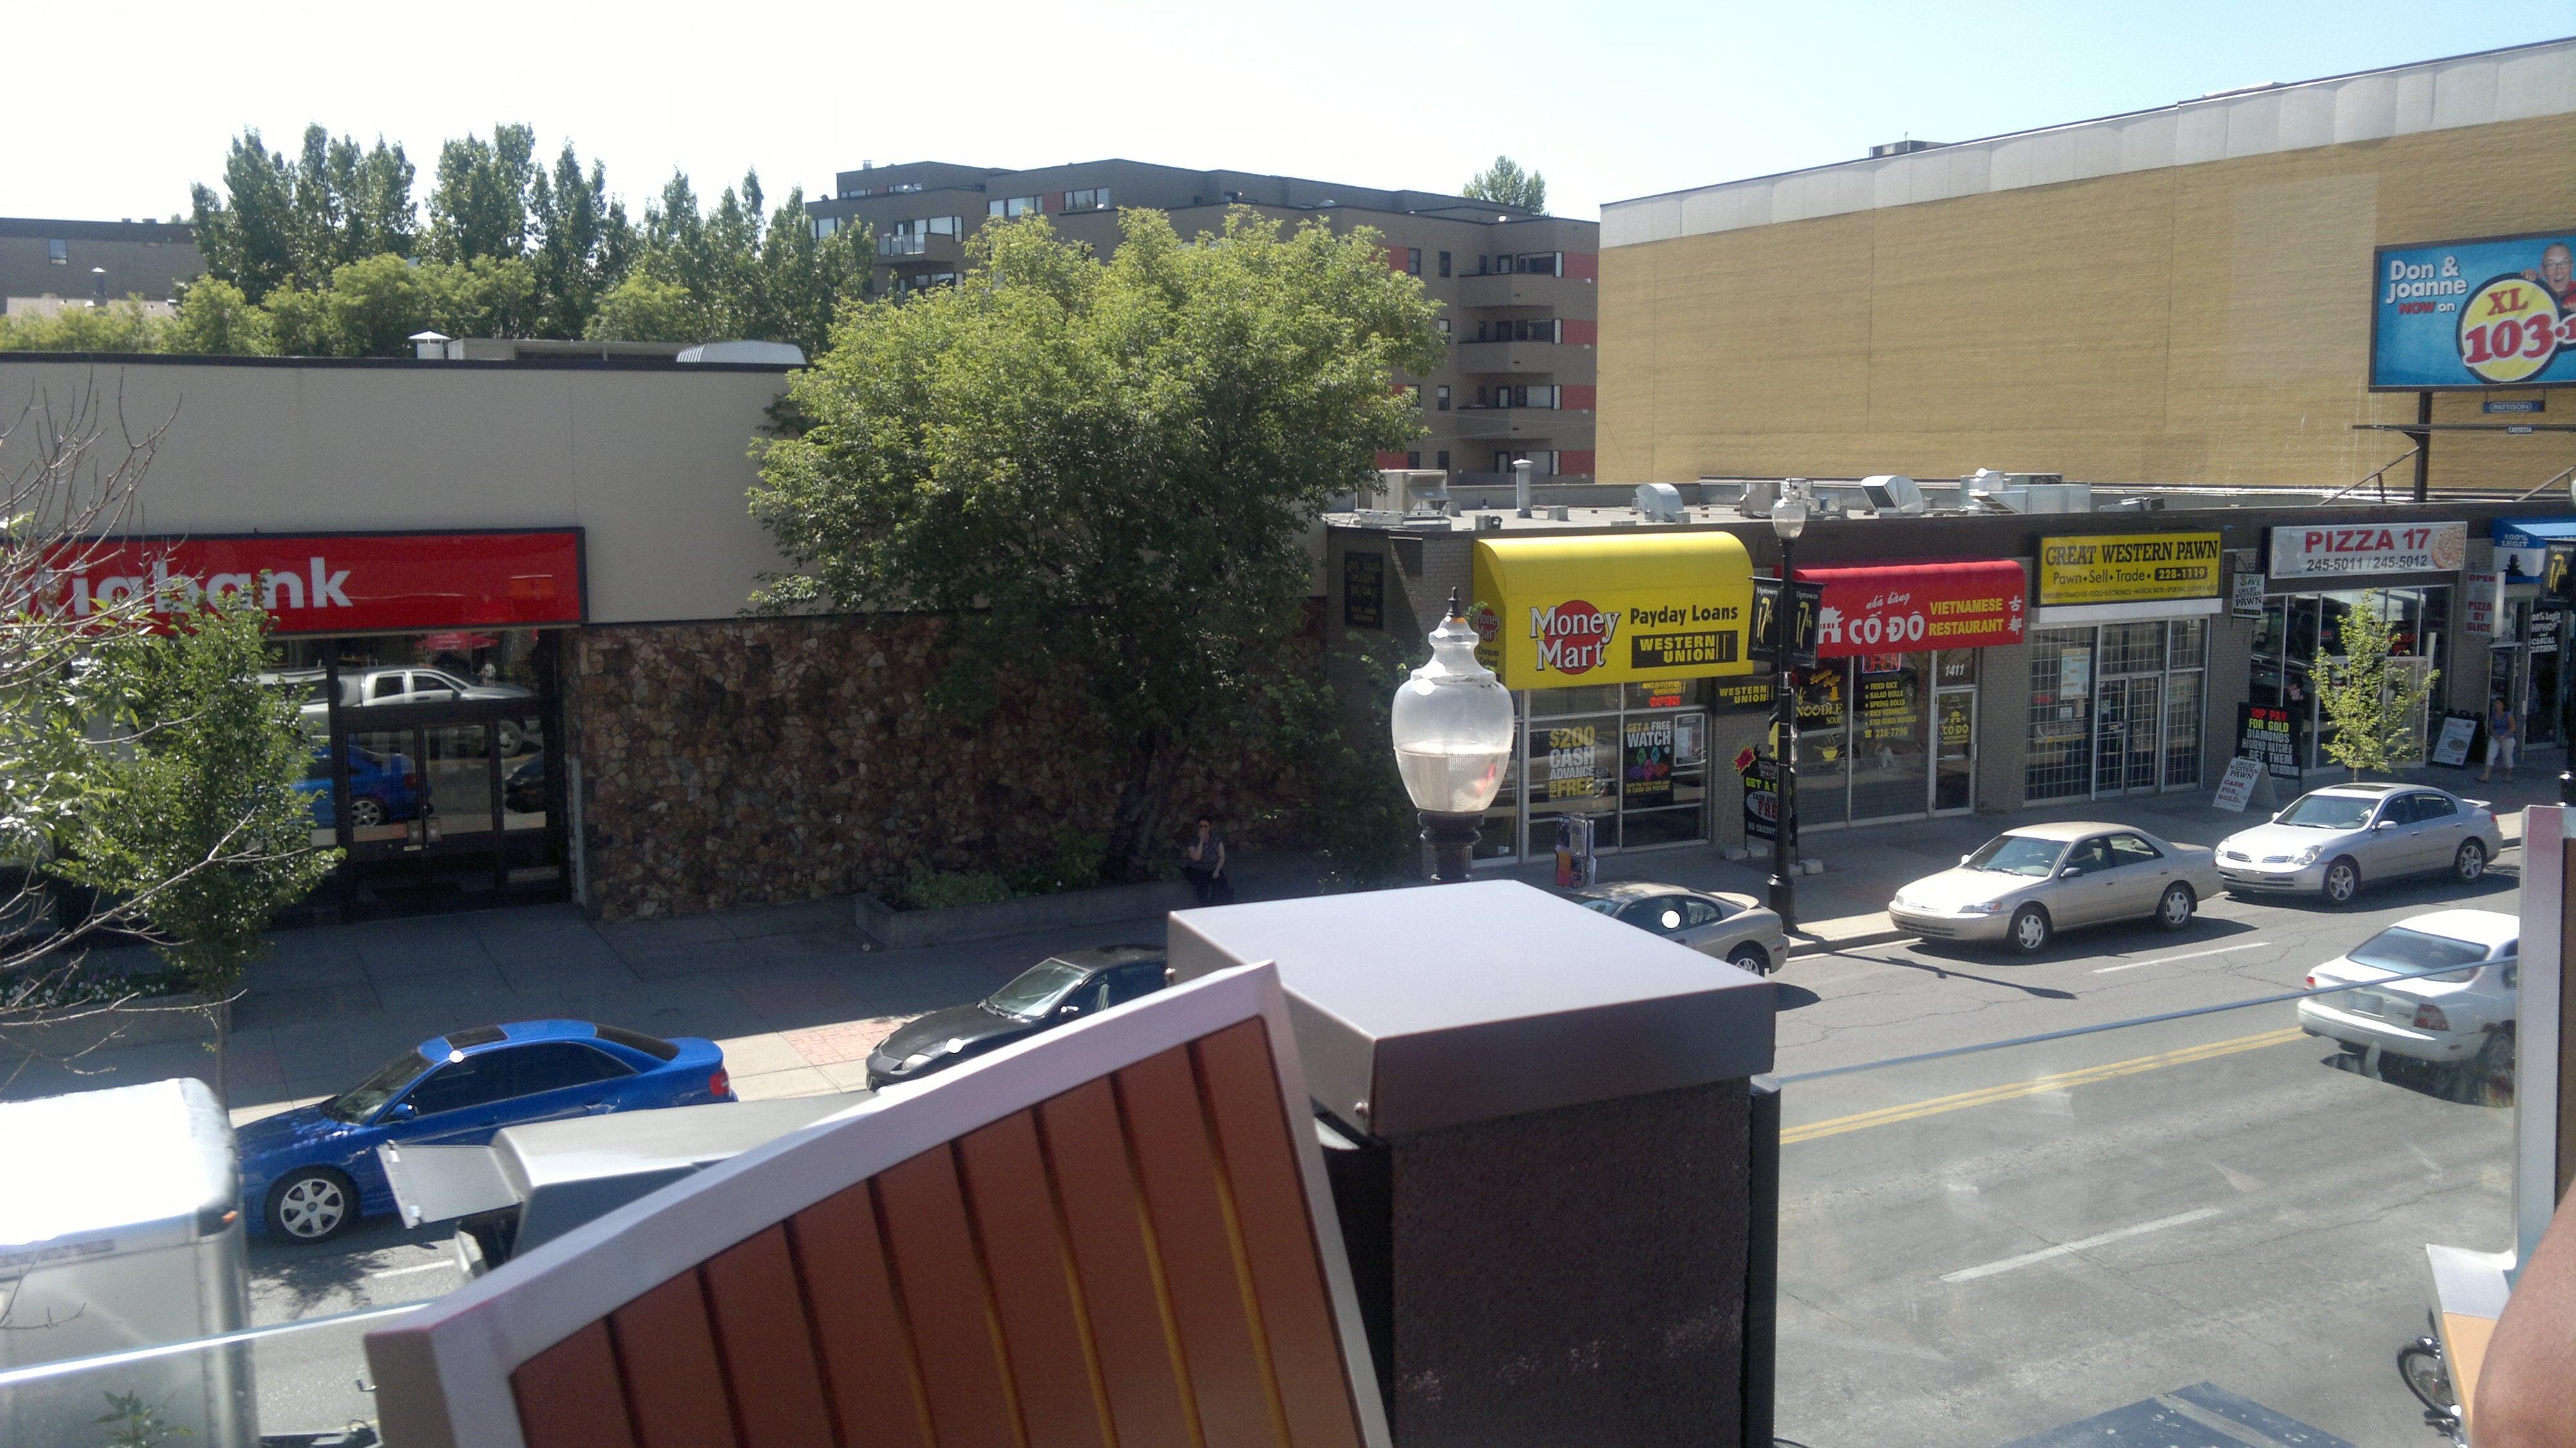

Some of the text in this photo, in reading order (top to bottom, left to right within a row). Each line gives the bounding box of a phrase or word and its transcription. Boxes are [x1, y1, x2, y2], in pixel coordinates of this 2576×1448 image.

[2391, 256, 2459, 281] Don &
[2399, 301, 2456, 314] NOW on
[2487, 287, 2529, 316] XL
[2305, 528, 2432, 553] PIZZA 17
[2045, 540, 2219, 566] GREAT WESTERN PAWN
[2307, 557, 2362, 571] 245-5011
[2373, 555, 2427, 567] 245-5012
[2053, 571, 2081, 585] Pawn
[2088, 569, 2108, 584] Sell
[2116, 568, 2145, 582] Trade
[1756, 586, 1778, 596] Uptown
[1796, 591, 1818, 600] Uptown
[1929, 598, 2003, 615] VIETNAMESE
[2236, 596, 2262, 606] PAWN
[2468, 601, 2492, 611] PIZZA
[1631, 605, 1738, 627] Payday Loans
[2474, 612, 2485, 621] BY
[1530, 605, 1620, 643] Money
[1929, 618, 2004, 636] RESTAURANT
[2467, 622, 2490, 632] SLICE
[1640, 634, 1715, 652] WESTERN
[1536, 639, 1606, 671] Mart
[1663, 647, 1715, 663] UNION
[1864, 653, 1899, 673] OPEN
[1945, 663, 1964, 677] 1411
[1719, 685, 1766, 697] WESTERN
[1734, 693, 1766, 704] UNION
[1796, 703, 1843, 718] NOODLE
[1627, 721, 1671, 732] GET A FREE
[2248, 718, 2289, 732] FOR GOLD
[1549, 726, 1595, 748] $200
[1627, 730, 1671, 748] WATCH
[2247, 729, 2290, 743] DIAMONDS
[1549, 747, 1595, 768] CASH
[2249, 750, 2293, 765] GET THEM
[1549, 765, 1595, 780] ADVANCE
[2230, 770, 2254, 780] PAWN
[1557, 777, 1594, 797] FREE
[1746, 777, 1761, 789] GET
[1764, 781, 1770, 791] A
